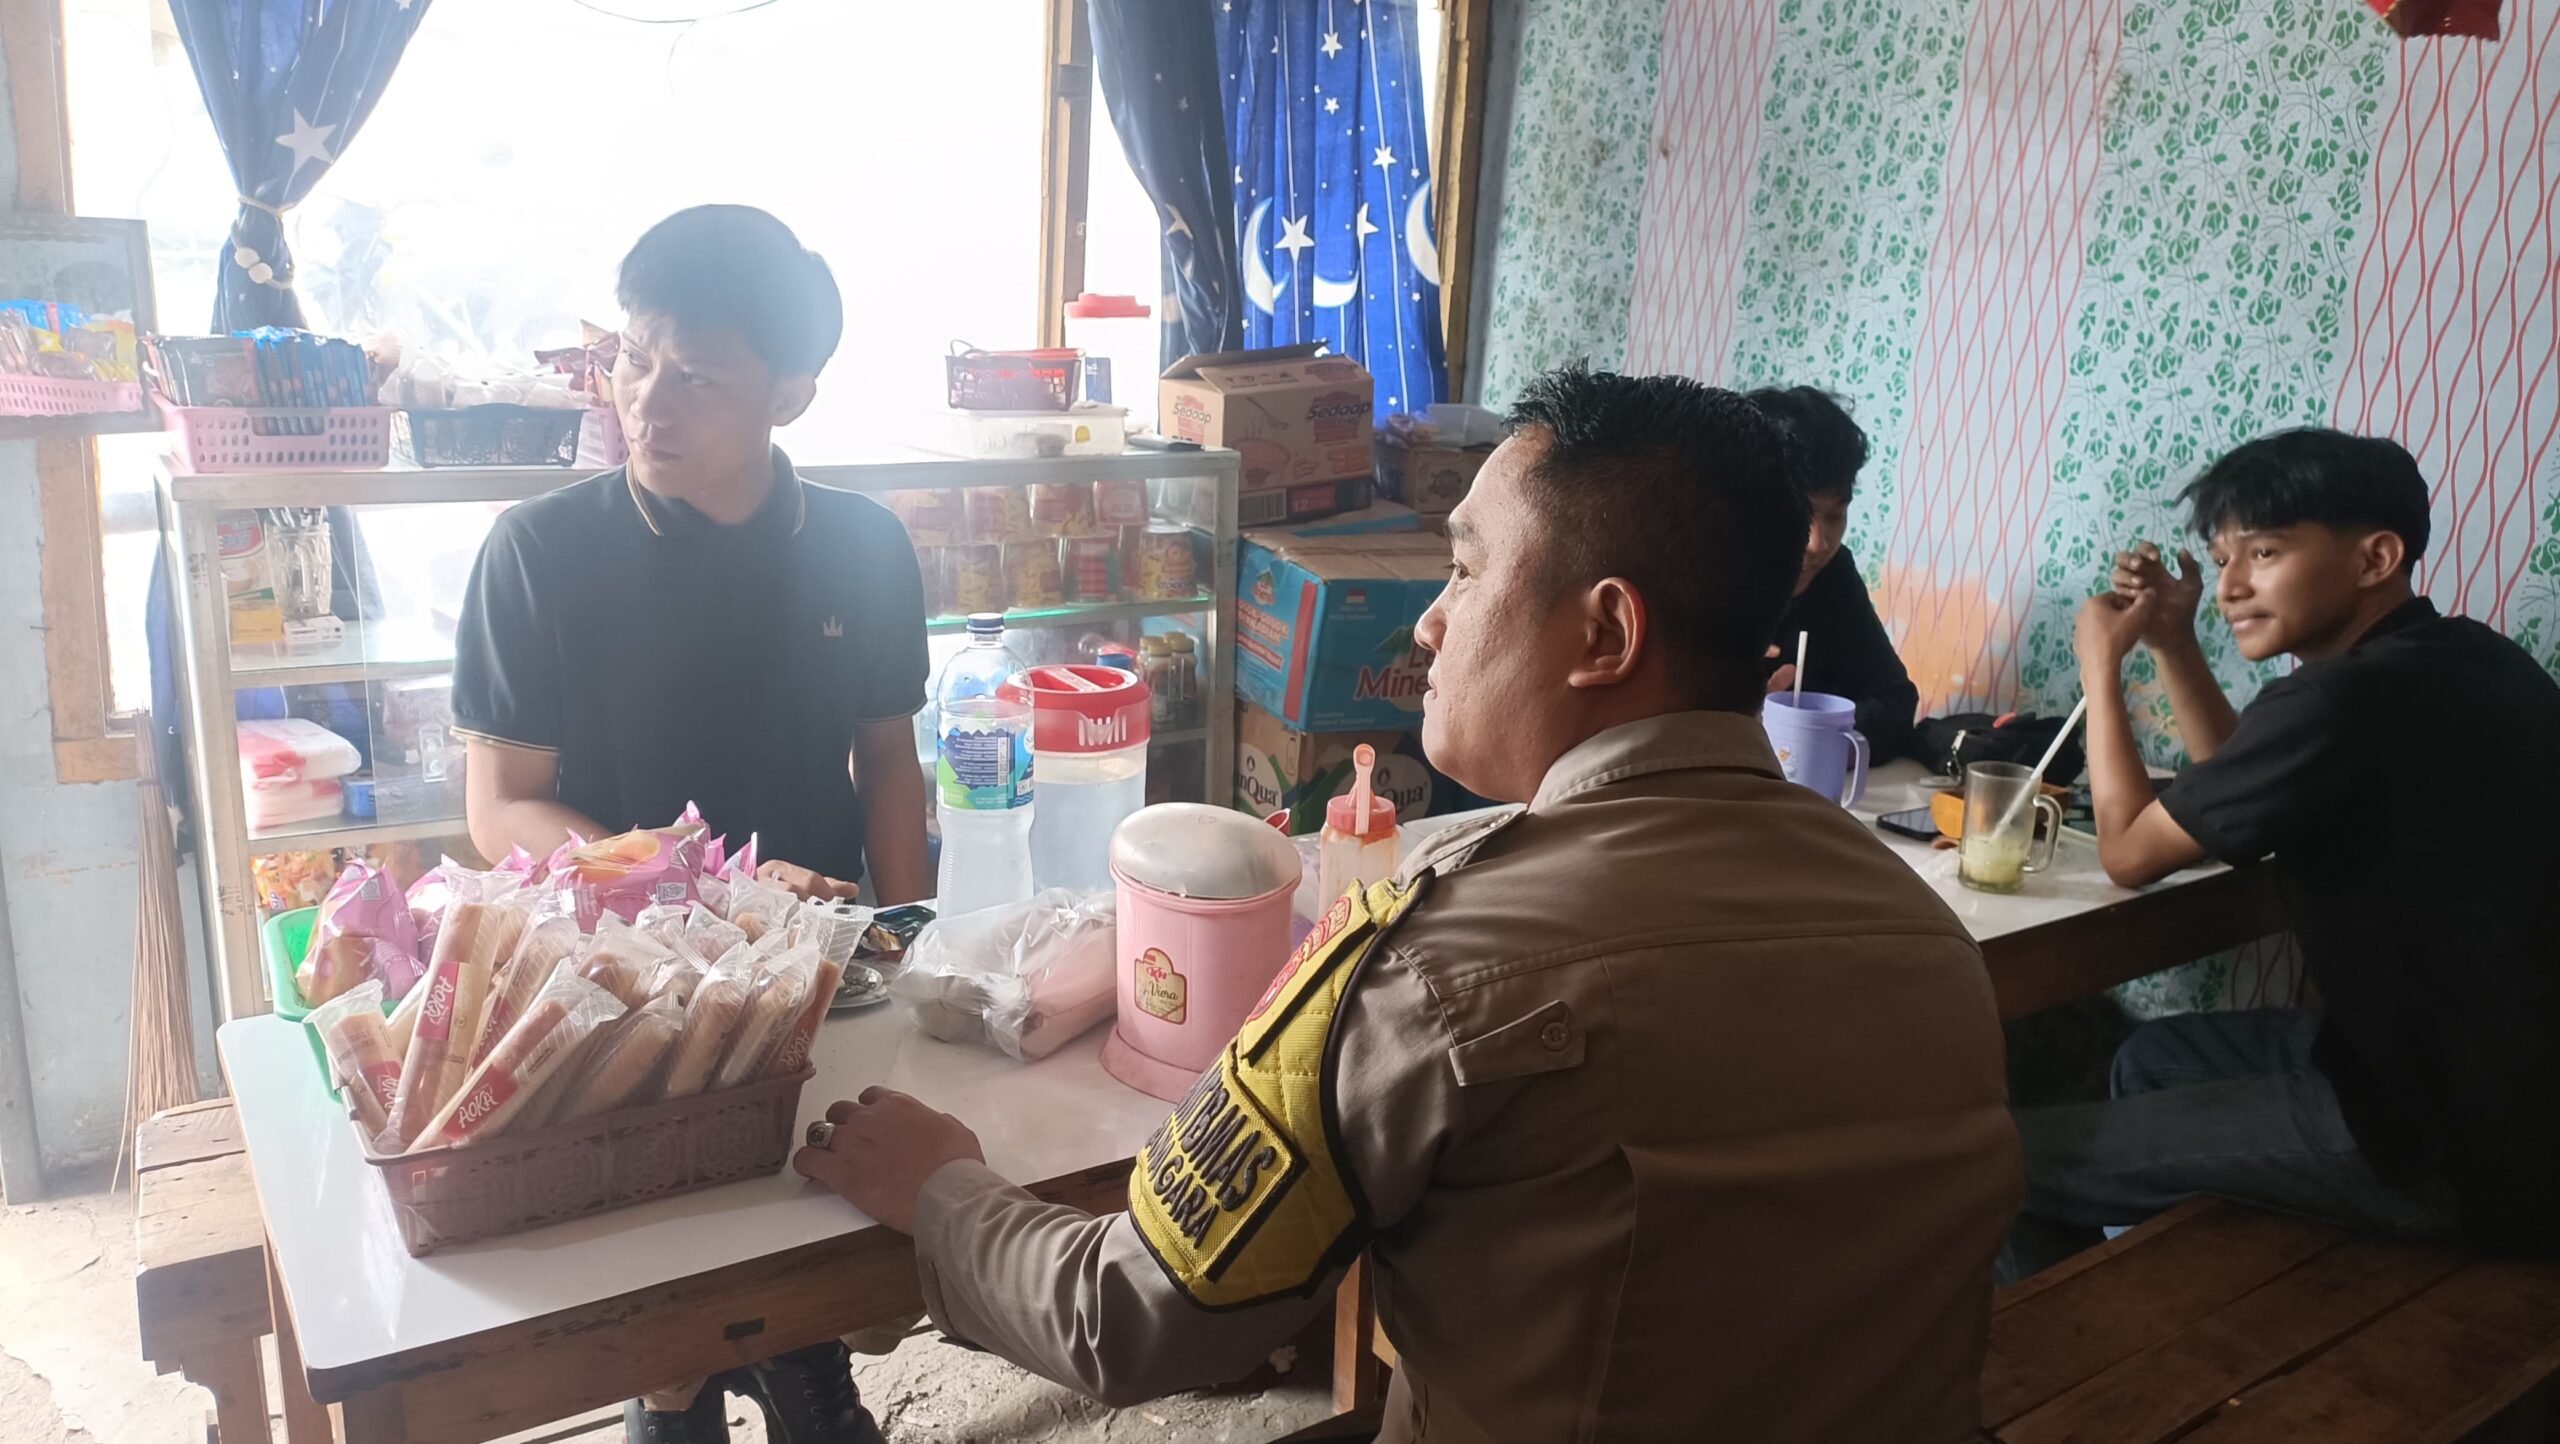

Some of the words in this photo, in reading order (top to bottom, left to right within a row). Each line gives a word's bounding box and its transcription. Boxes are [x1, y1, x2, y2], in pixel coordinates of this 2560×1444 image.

[1306, 401, 1371, 421] Sedaap
[1354, 665, 1431, 700] Mine
[1240, 774, 1277, 807] nQua
